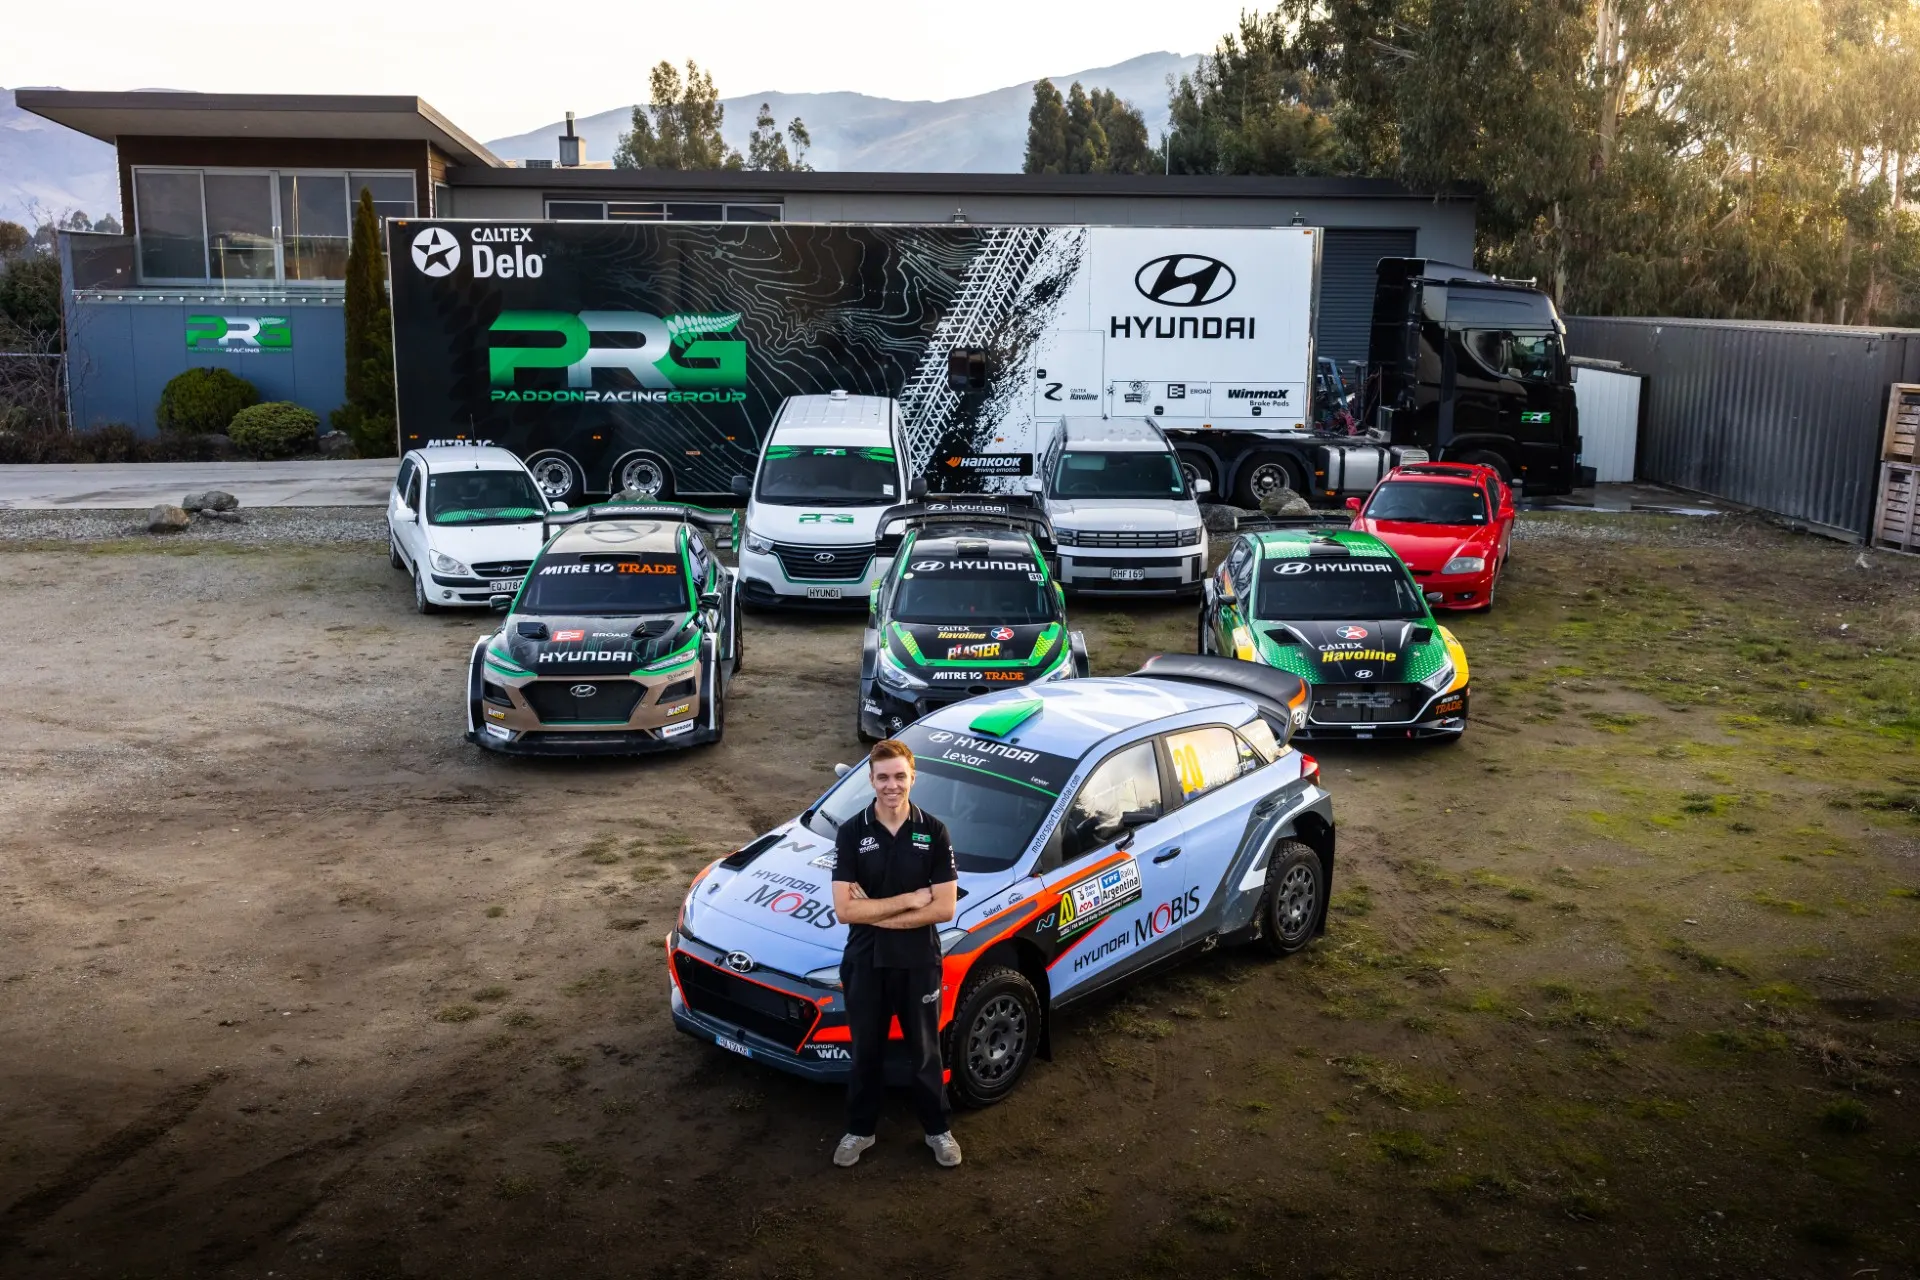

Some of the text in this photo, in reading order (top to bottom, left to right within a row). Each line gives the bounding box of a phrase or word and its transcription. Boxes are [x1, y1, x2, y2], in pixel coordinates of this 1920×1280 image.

[471, 228, 533, 242] CALTEX
[472, 245, 547, 278] Delo
[186, 315, 291, 346] PRG
[1110, 316, 1255, 339] HYUNDAI
[489, 310, 747, 388] PRG
[539, 562, 677, 576] MITRE 10 TRADE
[949, 560, 1037, 572] HYUNDAI
[1314, 562, 1393, 573] HYUNDAI
[937, 631, 987, 640] Havoline
[538, 650, 633, 663] HYUNDAI
[1318, 642, 1364, 651] CALTEX
[1322, 649, 1397, 663] Havoline
[932, 671, 1025, 681] MITRE 10 TRADE
[942, 748, 987, 766] Lexar
[953, 735, 1041, 764] HYUNDAI
[1031, 773, 1081, 854] motorsport.hyundai.com
[751, 869, 821, 895] HYUNDAI
[1103, 867, 1134, 886] YPF Rally
[1102, 876, 1139, 901] Argentina
[743, 884, 837, 929] MOBIS
[1134, 885, 1201, 947] MOBIS
[1074, 930, 1130, 973] HYUNDAI
